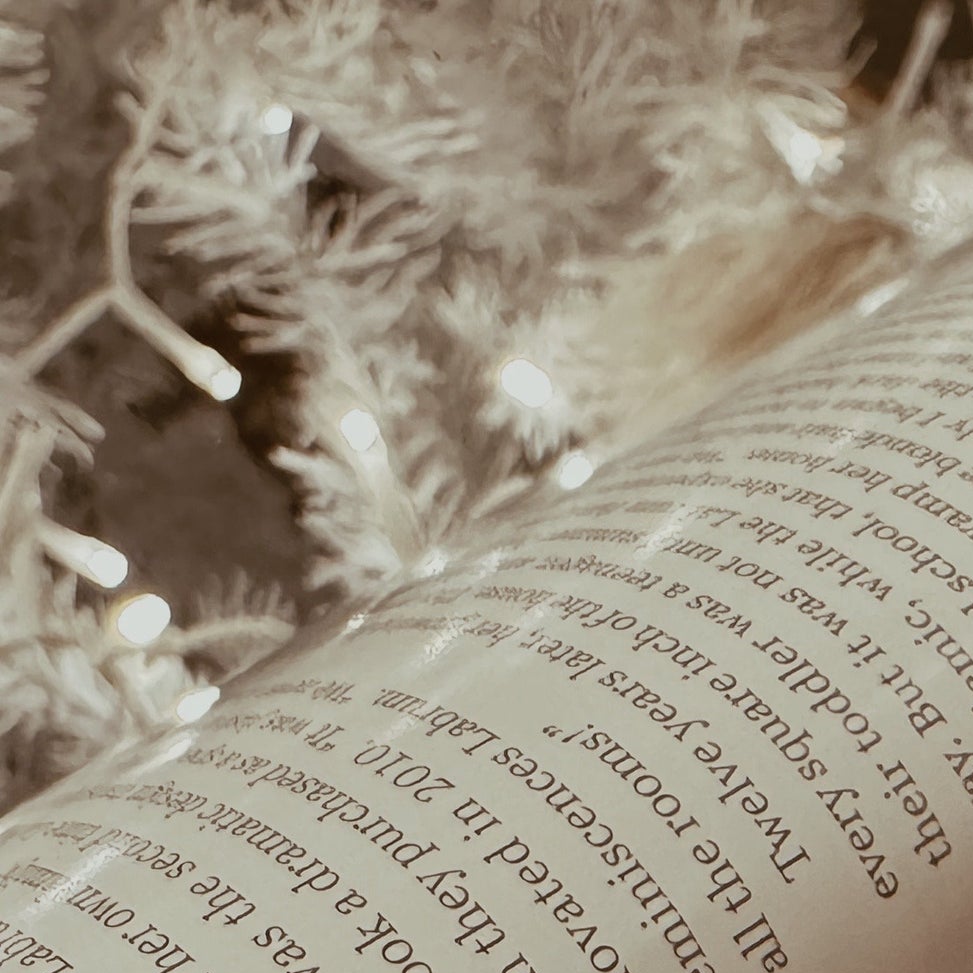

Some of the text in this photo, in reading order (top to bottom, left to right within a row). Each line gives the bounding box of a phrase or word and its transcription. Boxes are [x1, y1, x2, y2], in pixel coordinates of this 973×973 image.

[915, 410, 947, 428] I
[828, 461, 893, 494] her
[853, 430, 962, 478] blonde
[781, 487, 854, 521] that
[738, 516, 798, 546] the
[662, 581, 691, 600] a
[716, 555, 784, 590] not
[797, 539, 893, 602] while
[549, 594, 604, 621] the
[580, 609, 638, 631] of
[685, 594, 753, 639] was
[778, 587, 849, 637] was
[631, 624, 717, 681] inch
[846, 634, 887, 669] it
[751, 636, 882, 753] toddler
[880, 664, 948, 738] But
[372, 688, 501, 756] Labrum.
[709, 673, 828, 781] square
[353, 740, 456, 803] 2010.
[462, 619, 811, 884] Twelve years later, her
[247, 764, 440, 869] purchased
[452, 797, 503, 842] in
[876, 760, 952, 867] their
[197, 803, 340, 894] dramatic
[542, 724, 789, 973] all the rooms!”
[815, 788, 899, 899] every
[66, 884, 136, 929] own
[189, 875, 256, 926] the
[334, 888, 368, 916] a
[415, 869, 506, 955] they
